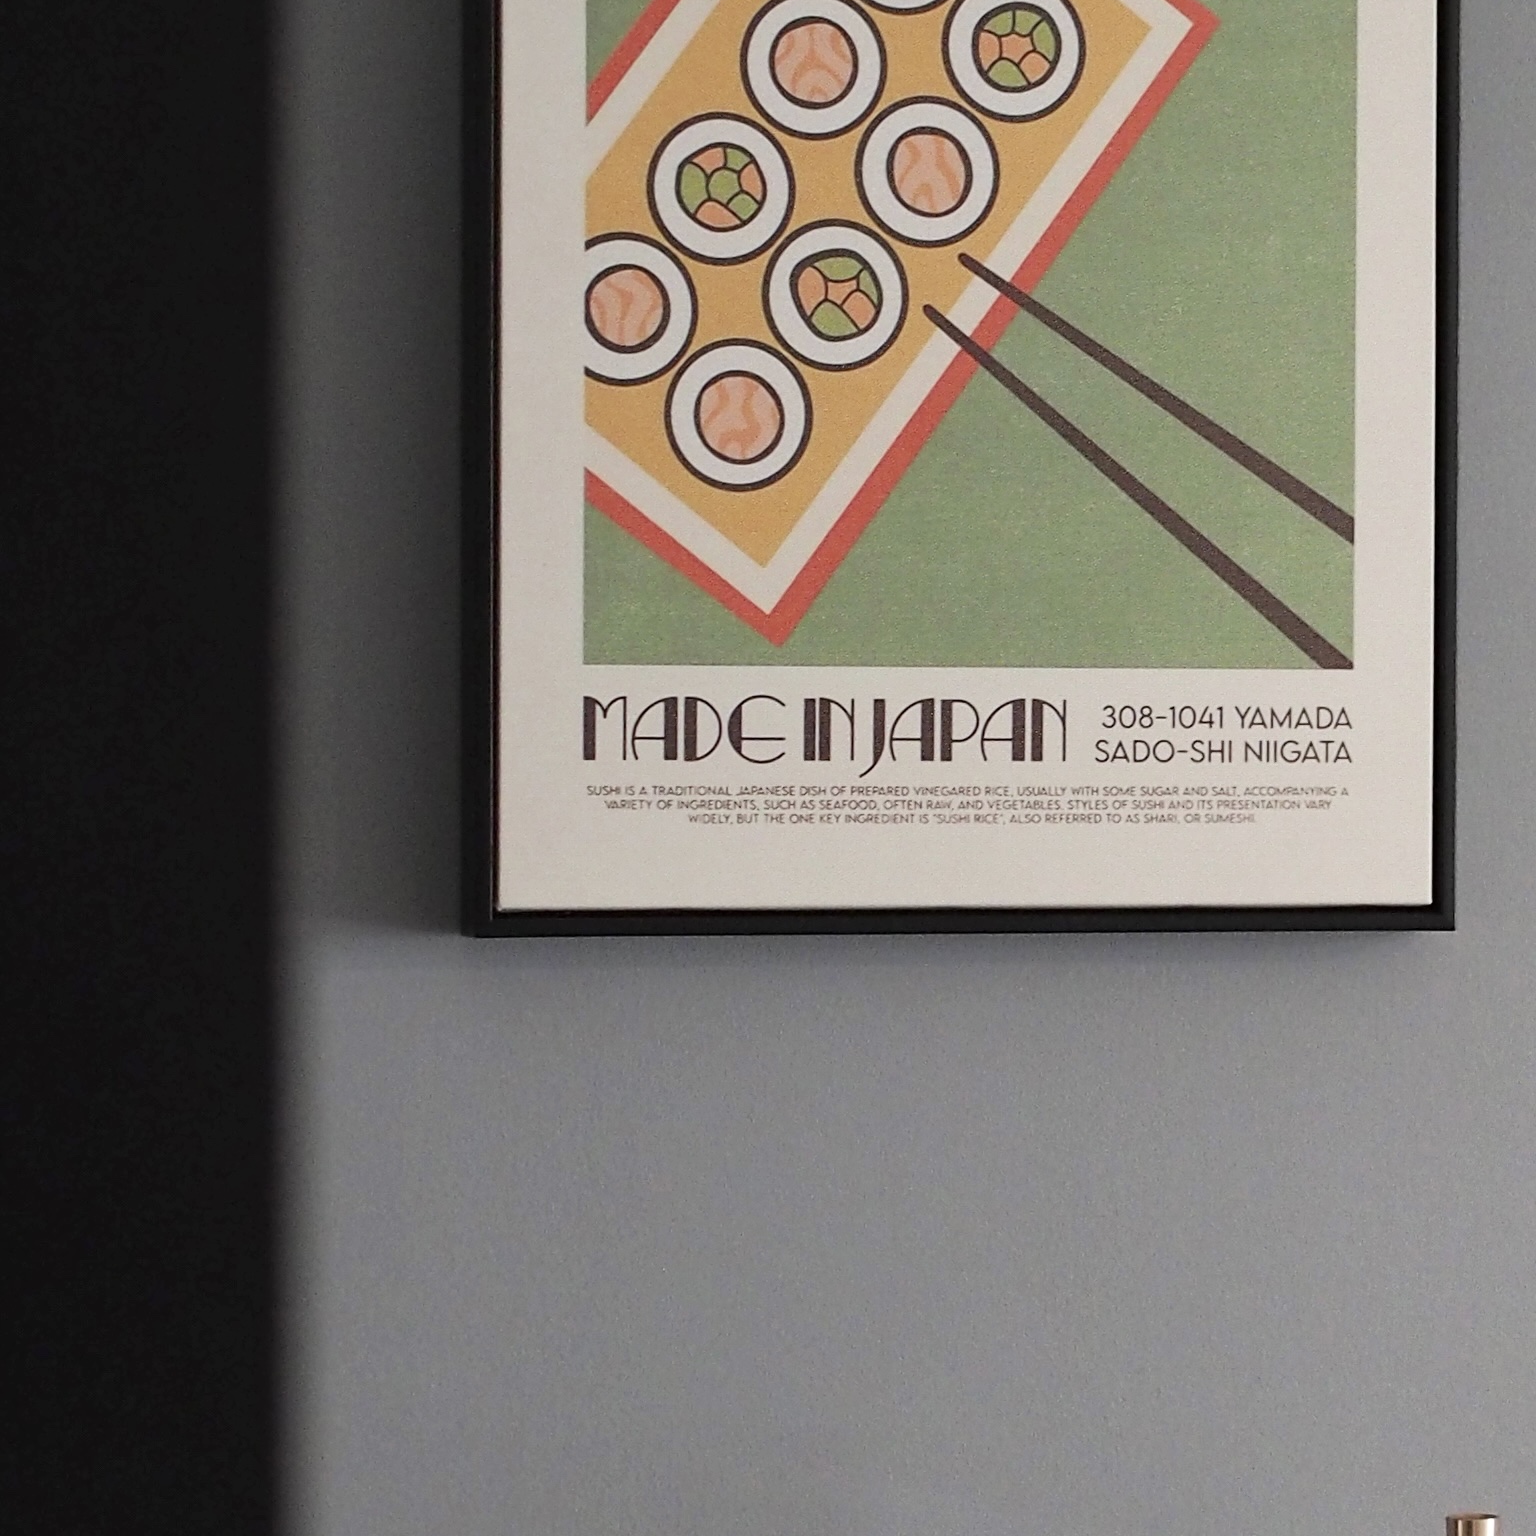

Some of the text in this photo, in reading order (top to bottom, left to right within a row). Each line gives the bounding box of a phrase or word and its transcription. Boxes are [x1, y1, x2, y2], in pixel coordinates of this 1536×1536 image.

[1101, 705, 1353, 730] 308-1041 YAMADA
[582, 694, 1067, 778] MADE IN JAPAN
[1094, 739, 1353, 764] SADO-SHI NIIGATA
[587, 785, 1349, 797] SUSHI IS A TRADITIONAL JAPANESE DISH OF PREPARED VINEGARED RICE, USUALLY WITH SOME SUGAR AND SALT, ACCOMPANYING A
[604, 799, 651, 810] VARIETY
[656, 799, 673, 810] OF
[677, 799, 760, 810] INGREDIENTS,
[763, 799, 796, 810] SUCH
[800, 799, 815, 810] AS
[819, 799, 880, 810] SEAFOOD,
[883, 799, 923, 810] OFTEN
[957, 799, 983, 810] AND
[1067, 799, 1108, 810] STYLES
[1112, 799, 1129, 810] OF
[1132, 799, 1165, 810] SUSHI
[1168, 799, 1194, 810] AND
[1197, 799, 1213, 810] ITS
[1217, 799, 1300, 810] PRESENTATION
[1304, 799, 1332, 810] VARY
[688, 814, 733, 824] WIDELY,
[736, 814, 759, 824] BUT
[764, 814, 786, 824] THE
[789, 814, 815, 824] ONE
[819, 814, 841, 824] KEY
[845, 814, 915, 824] INGREDIENT
[919, 814, 929, 824] IS
[1010, 814, 1042, 824] ALSO
[1045, 814, 1101, 824] REFERRED
[1106, 814, 1122, 824] TO
[1126, 814, 1140, 824] AS
[1184, 814, 1201, 824] OR
